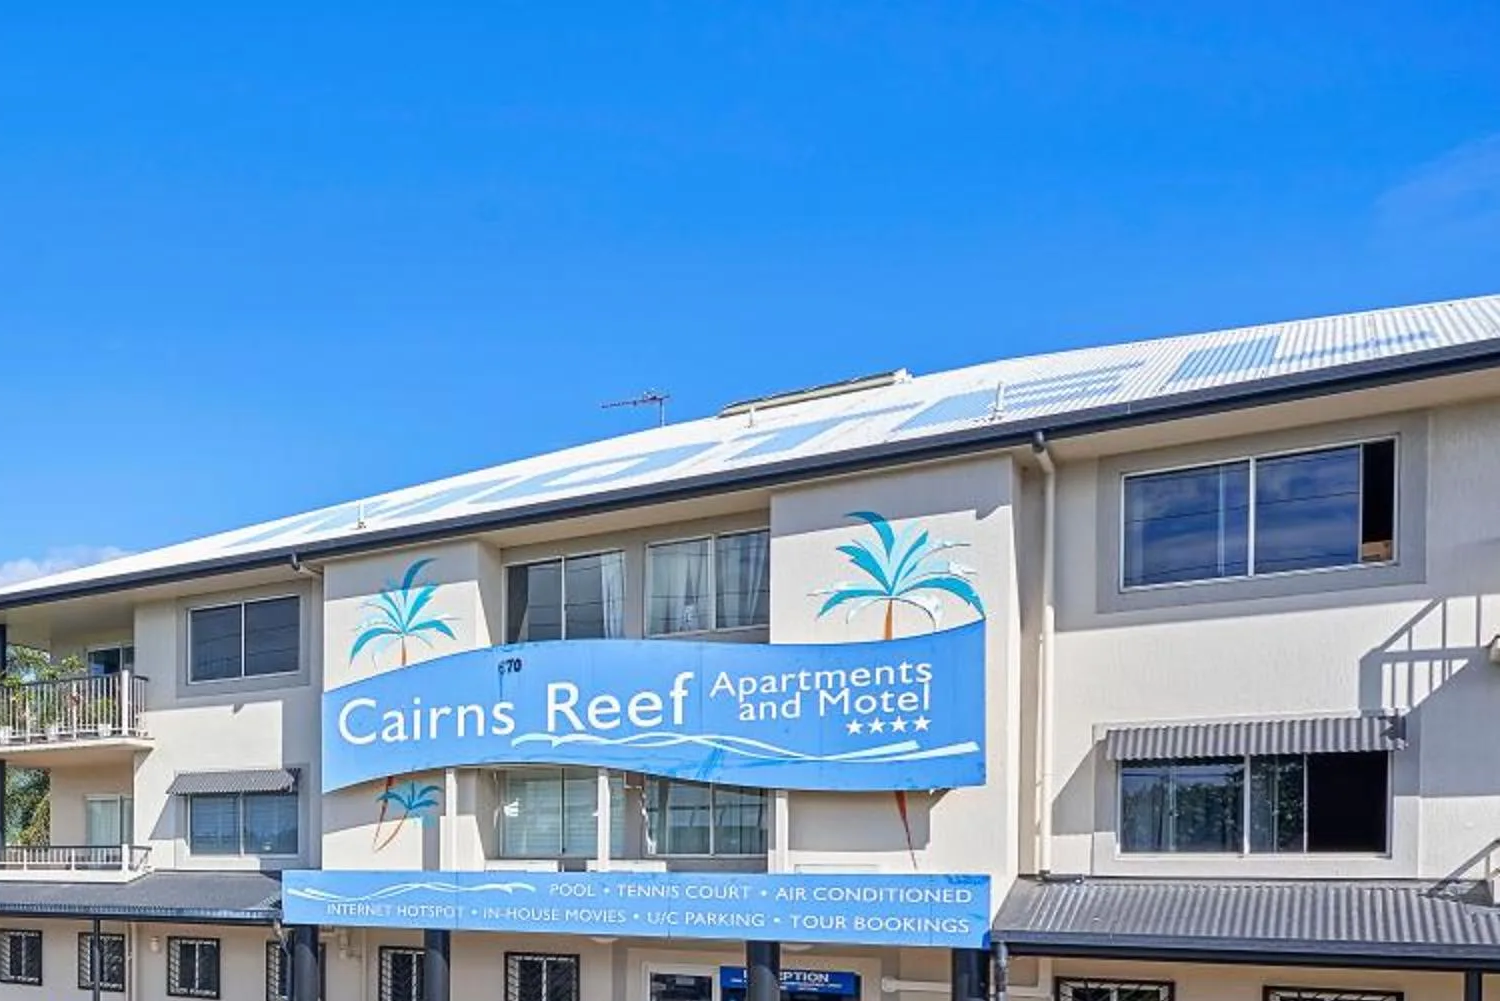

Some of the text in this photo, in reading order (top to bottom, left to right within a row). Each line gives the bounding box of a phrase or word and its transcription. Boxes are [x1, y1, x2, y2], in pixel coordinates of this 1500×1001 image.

[222, 331, 1439, 547] MOTEL
[709, 661, 933, 701] Apartments
[739, 681, 930, 721] and Motel
[338, 671, 694, 745] Cairns Reef
[550, 884, 972, 904] POOL TENNIS COURT AIR CONDITIONED
[327, 903, 970, 933] INTERNET HOTSPOT IN-HOUSE MOVIES U/C PARKING TOUR BOOKINGS
